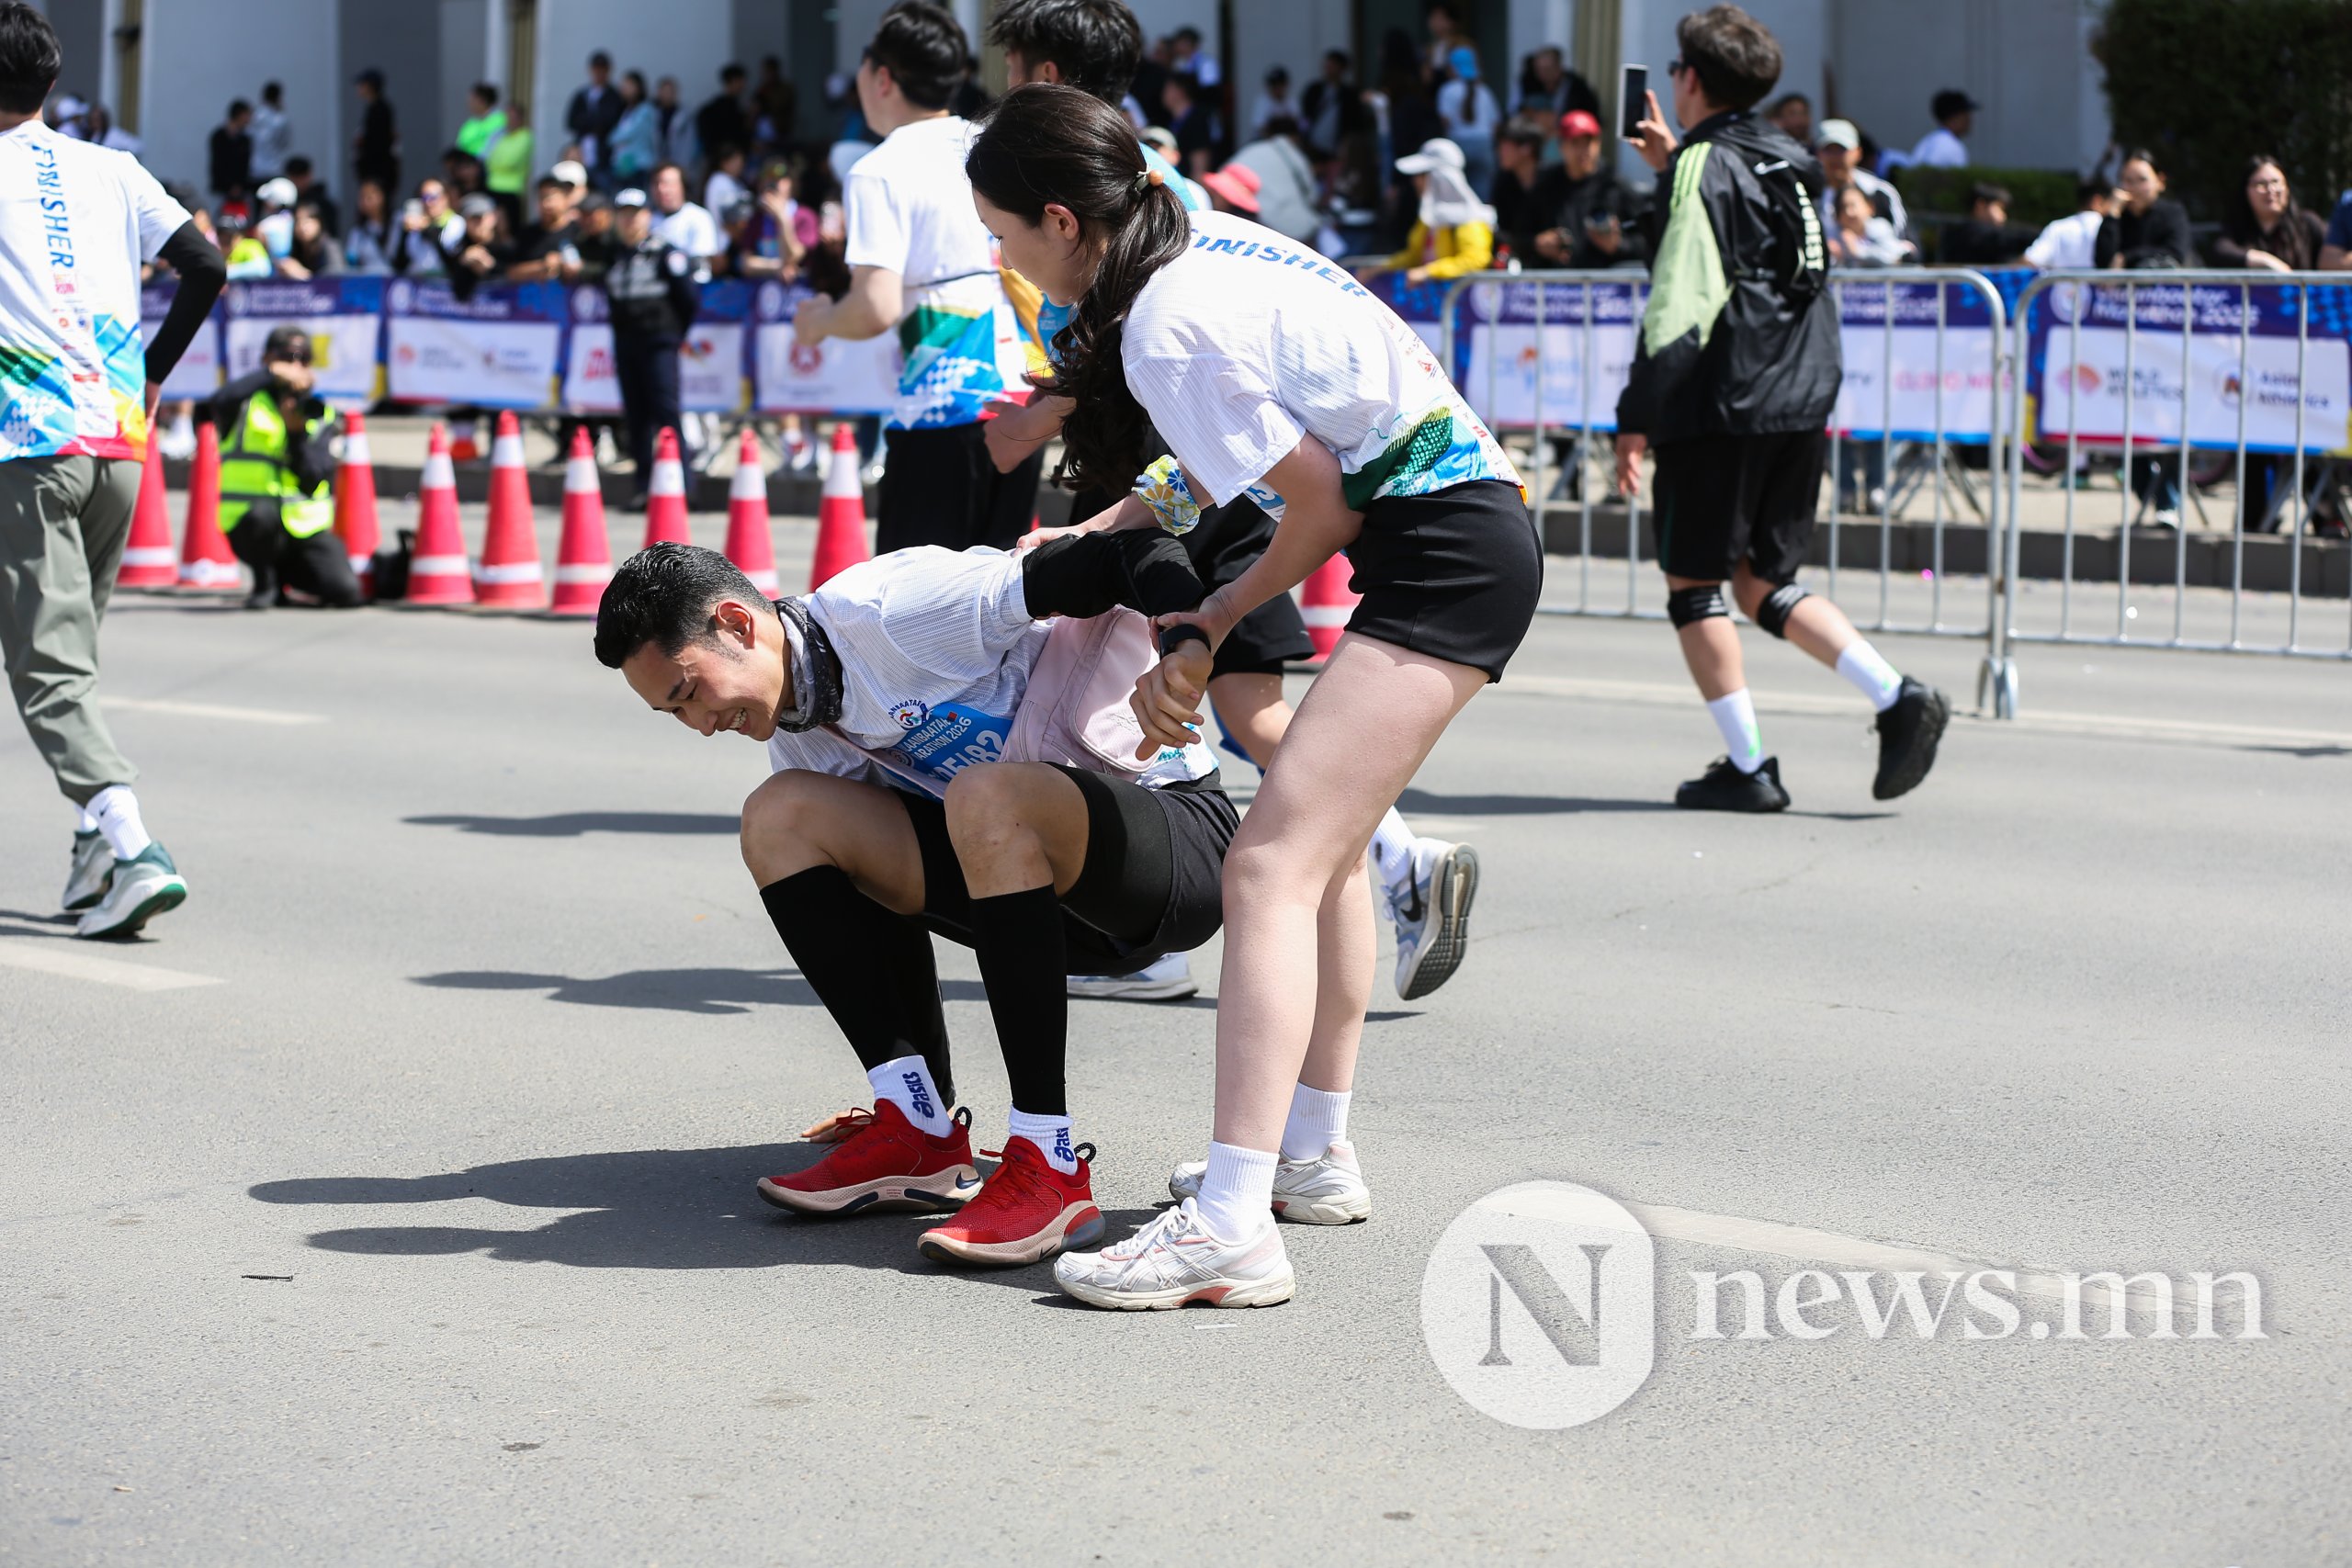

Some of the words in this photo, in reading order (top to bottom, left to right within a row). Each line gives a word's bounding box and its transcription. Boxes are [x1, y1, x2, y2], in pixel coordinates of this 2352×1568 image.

[1191, 228, 1368, 298] INISHER
[911, 733, 953, 761] ARATHON
[945, 716, 973, 740] 2026
[901, 1071, 935, 1120] asics
